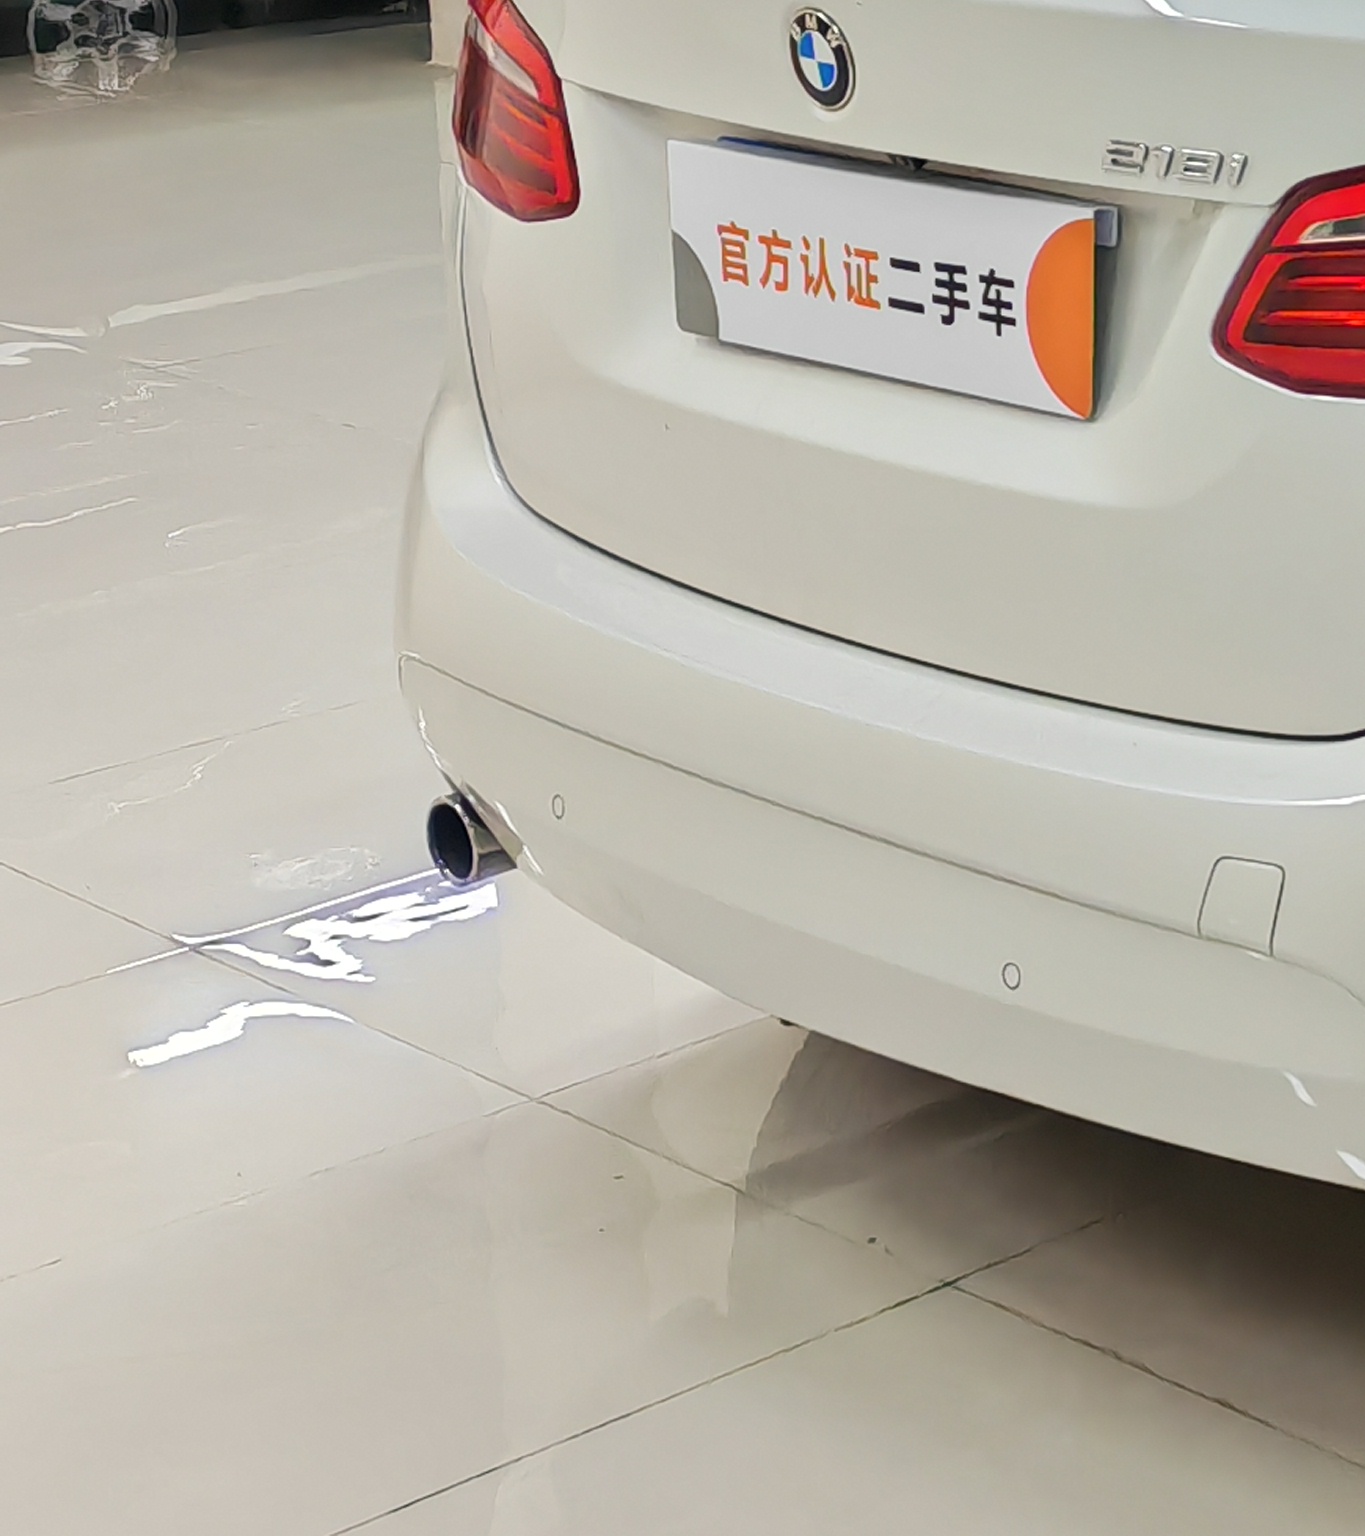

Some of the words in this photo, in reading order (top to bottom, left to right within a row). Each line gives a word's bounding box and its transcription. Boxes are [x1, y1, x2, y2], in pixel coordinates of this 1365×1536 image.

[717, 220, 1017, 337] 官方认证二手车
